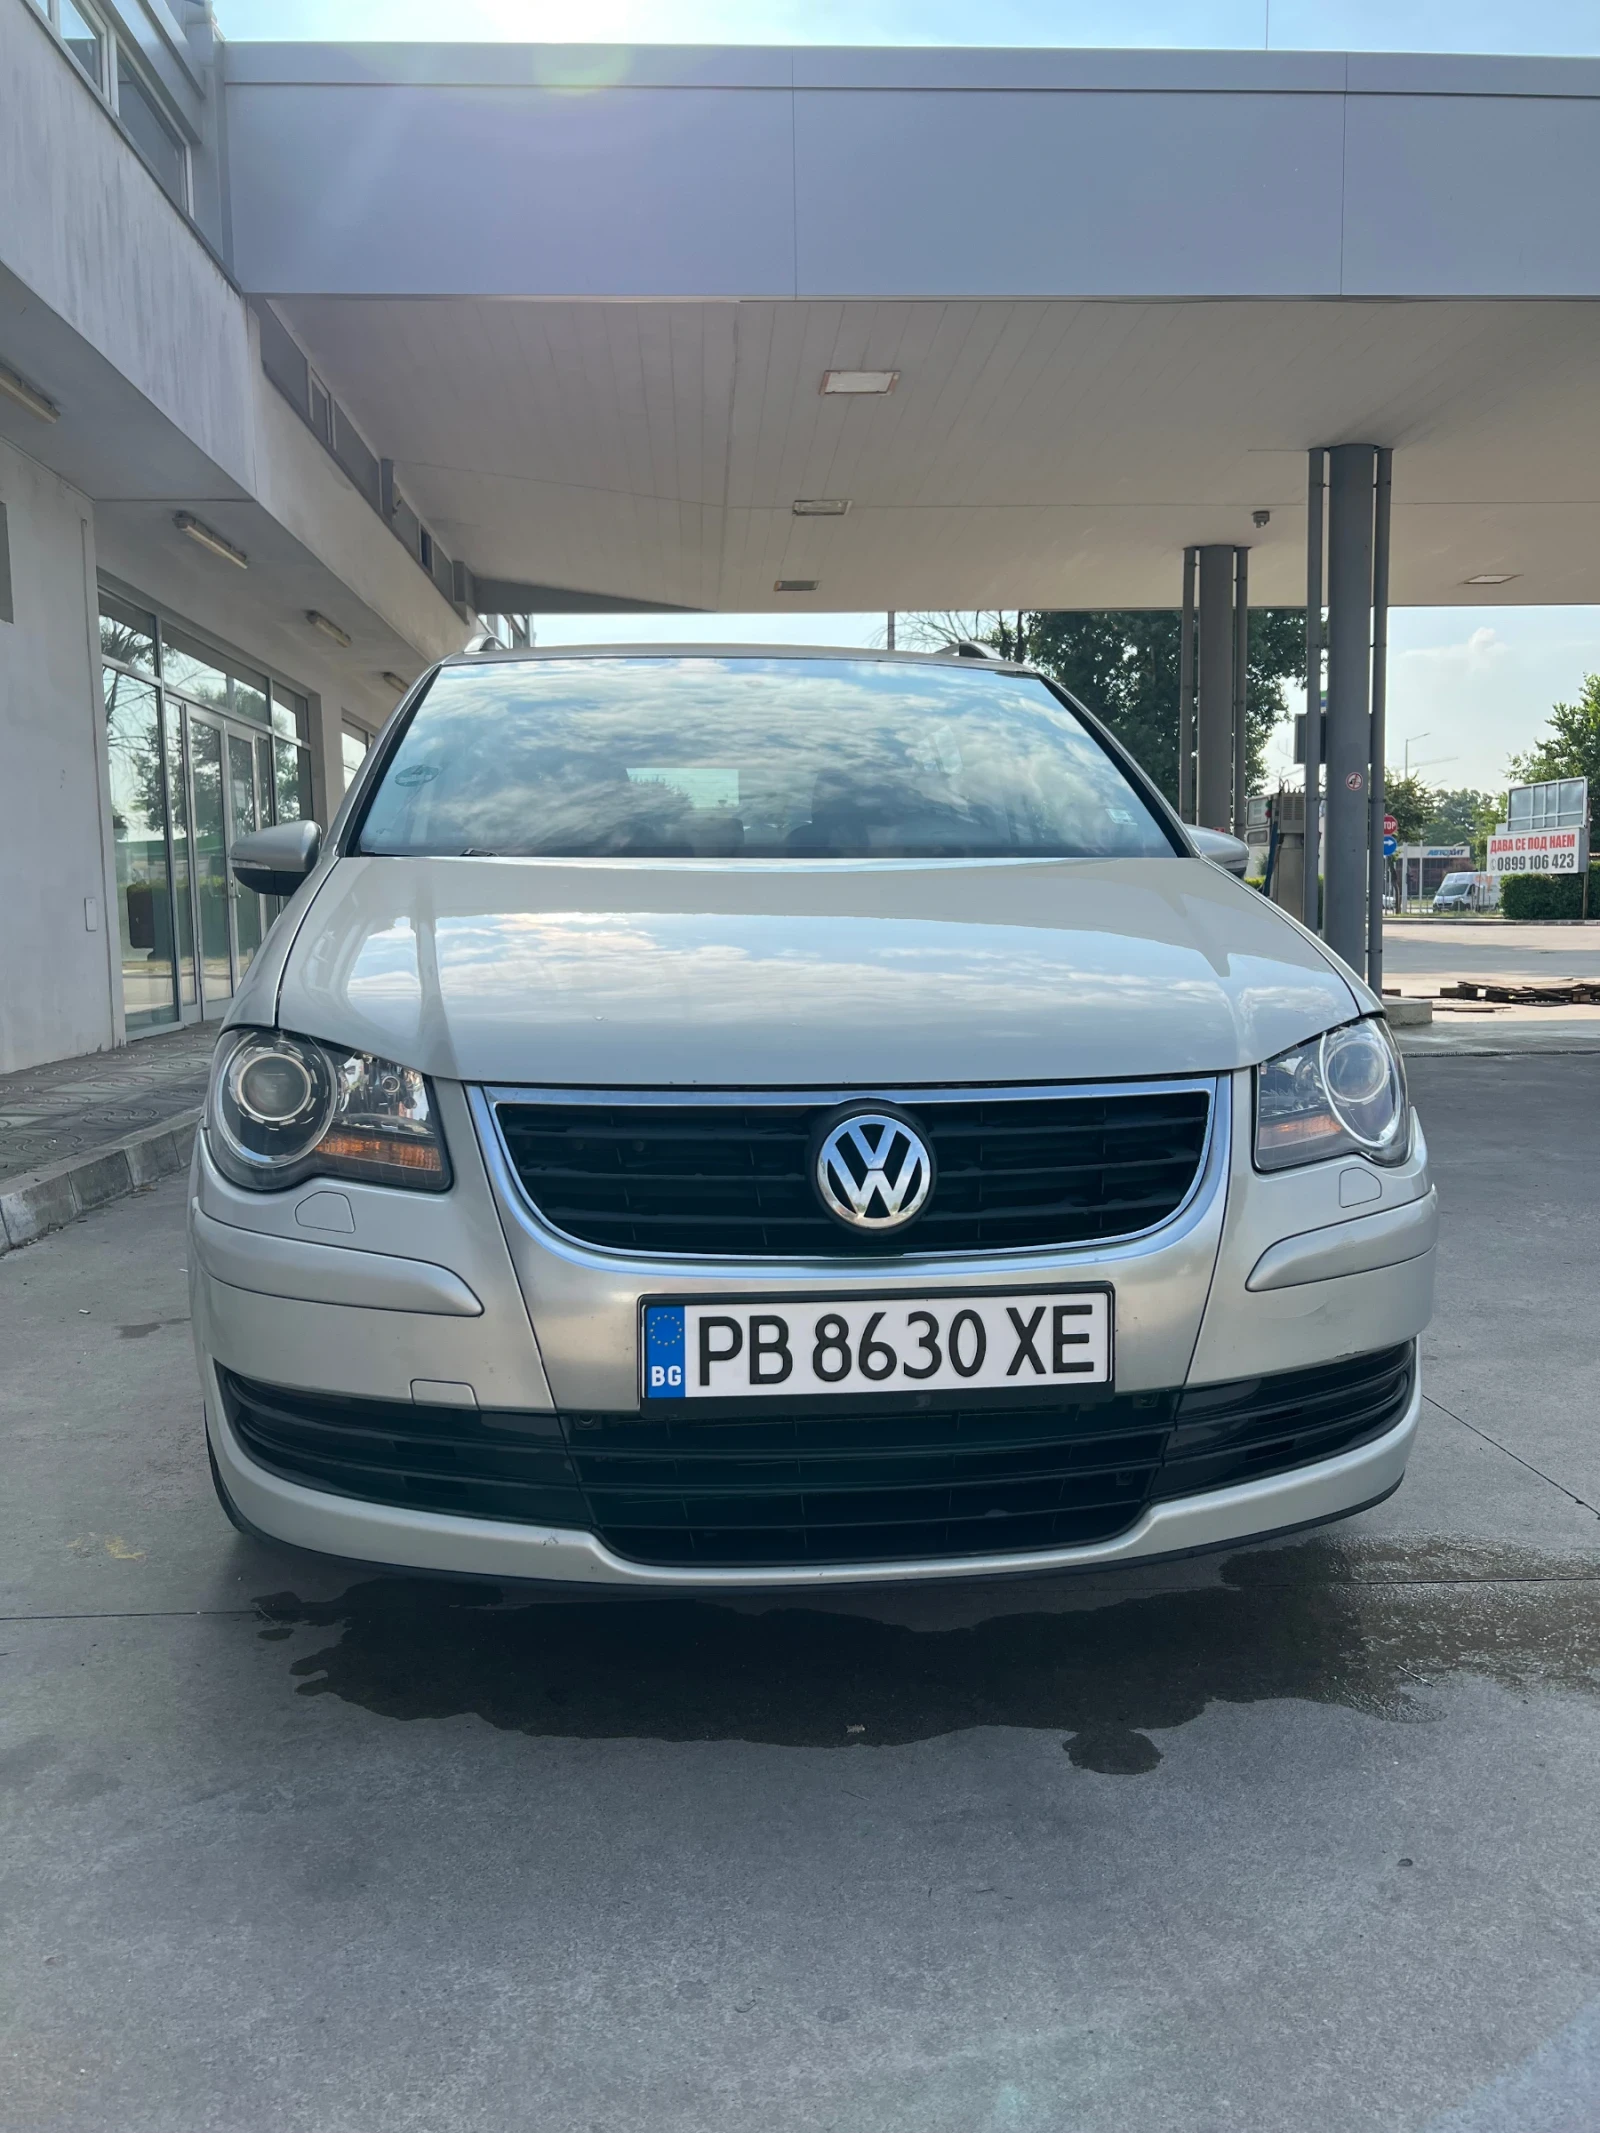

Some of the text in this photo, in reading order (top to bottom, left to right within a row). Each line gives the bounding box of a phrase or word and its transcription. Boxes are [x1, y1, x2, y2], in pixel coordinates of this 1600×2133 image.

[1384, 821, 1396, 829] TOP
[1490, 834, 1575, 854] ДАВА СЕ ПОД НАЕМ
[1497, 853, 1575, 871] 0899 106 423
[818, 1114, 931, 1229] VW
[699, 1303, 1095, 1387] PB 8630 XE
[651, 1365, 682, 1387] BG
